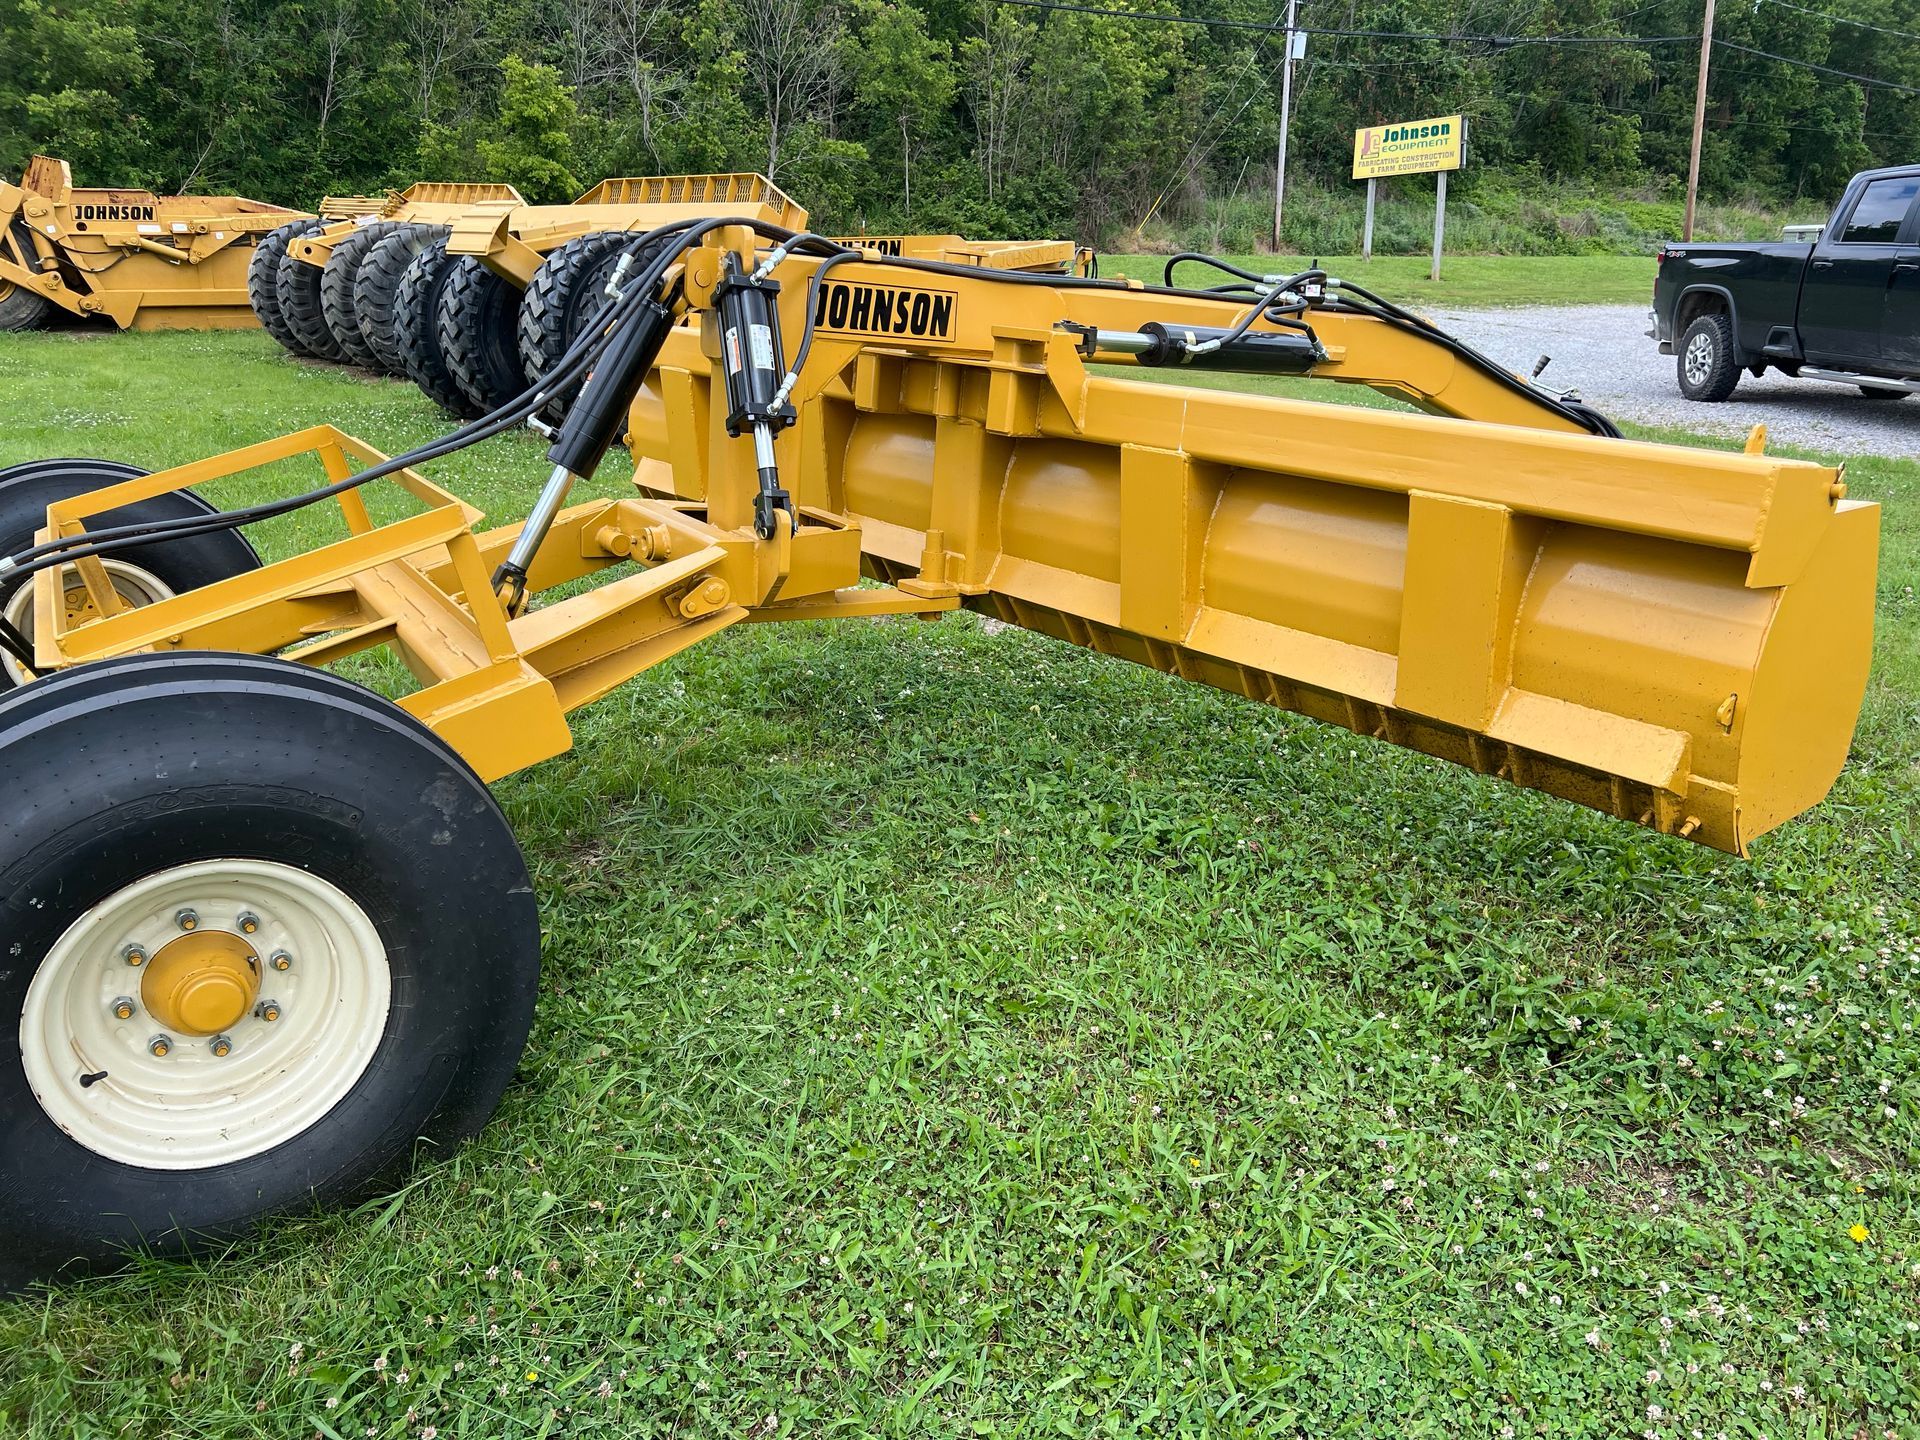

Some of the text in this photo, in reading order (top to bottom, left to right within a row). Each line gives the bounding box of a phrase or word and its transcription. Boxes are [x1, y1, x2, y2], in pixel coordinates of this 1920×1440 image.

[1382, 123, 1450, 143] Johnson
[1382, 138, 1449, 153] EQUIPMENT
[1358, 151, 1455, 168] FABRICATING CONSTRUCTION
[1377, 164, 1396, 173] FARM
[1398, 160, 1440, 171] EQUIPMENT
[75, 205, 154, 221] JOHNSON
[815, 283, 952, 337] JOHNSON
